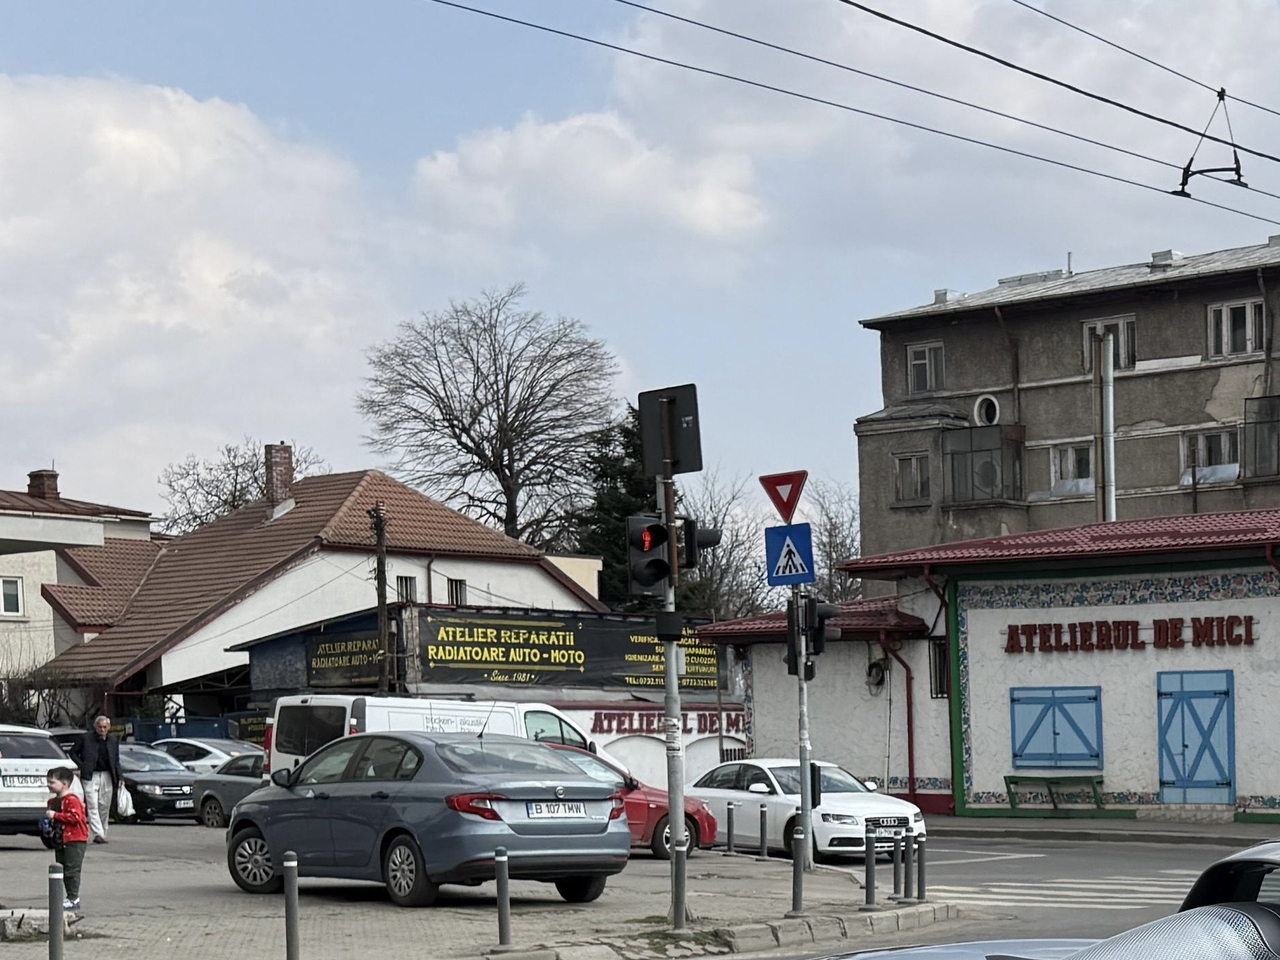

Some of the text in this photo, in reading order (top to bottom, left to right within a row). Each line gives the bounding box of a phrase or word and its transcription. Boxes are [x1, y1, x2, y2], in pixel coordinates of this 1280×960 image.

[438, 626, 575, 646] ATELIER REPARATII
[1005, 615, 1254, 654] ATELIERUL DE MICI
[351, 654, 368, 666] AUTO
[428, 645, 506, 662] RADIATOARE
[509, 648, 541, 662] AUTO
[550, 650, 585, 664] MOTO
[512, 672, 530, 682] 1981
[698, 712, 719, 734] DE
[535, 803, 582, 814] B 107 TMW
